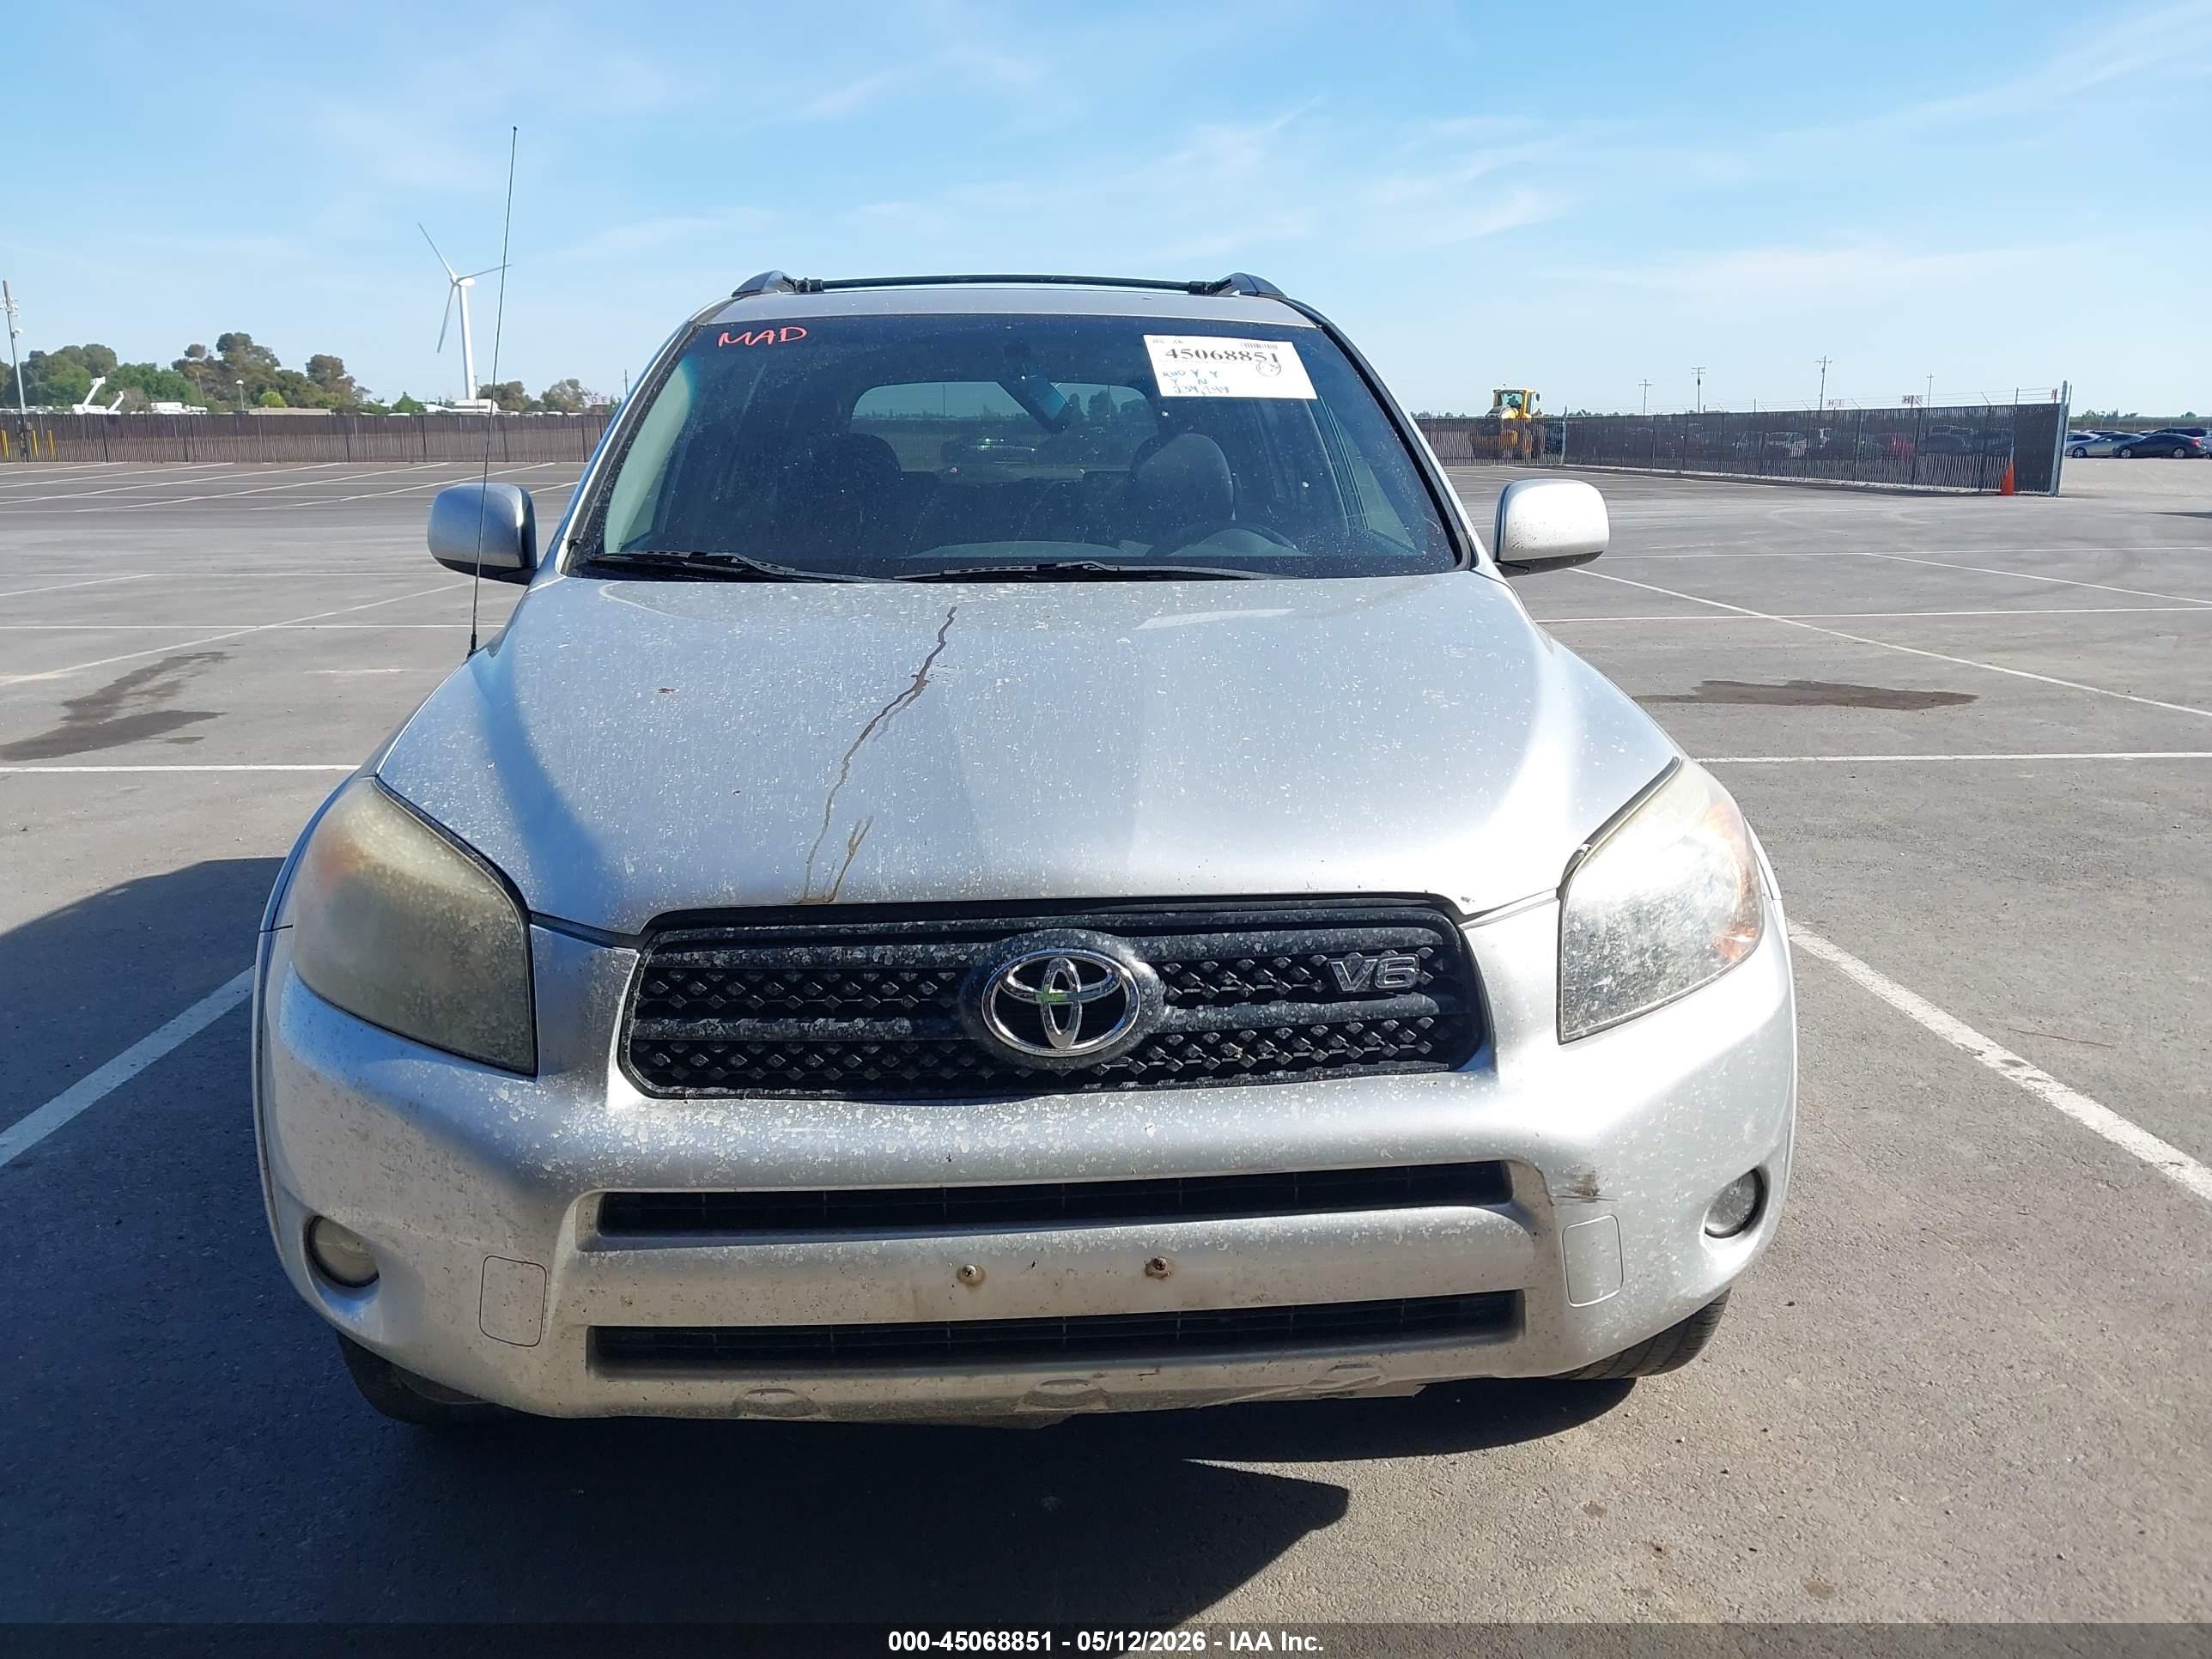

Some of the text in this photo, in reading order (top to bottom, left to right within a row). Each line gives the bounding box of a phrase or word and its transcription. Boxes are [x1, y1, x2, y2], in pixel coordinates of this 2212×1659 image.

[718, 326, 807, 347] MAD
[1164, 348, 1279, 363] 45068851
[1329, 955, 1417, 991] V6
